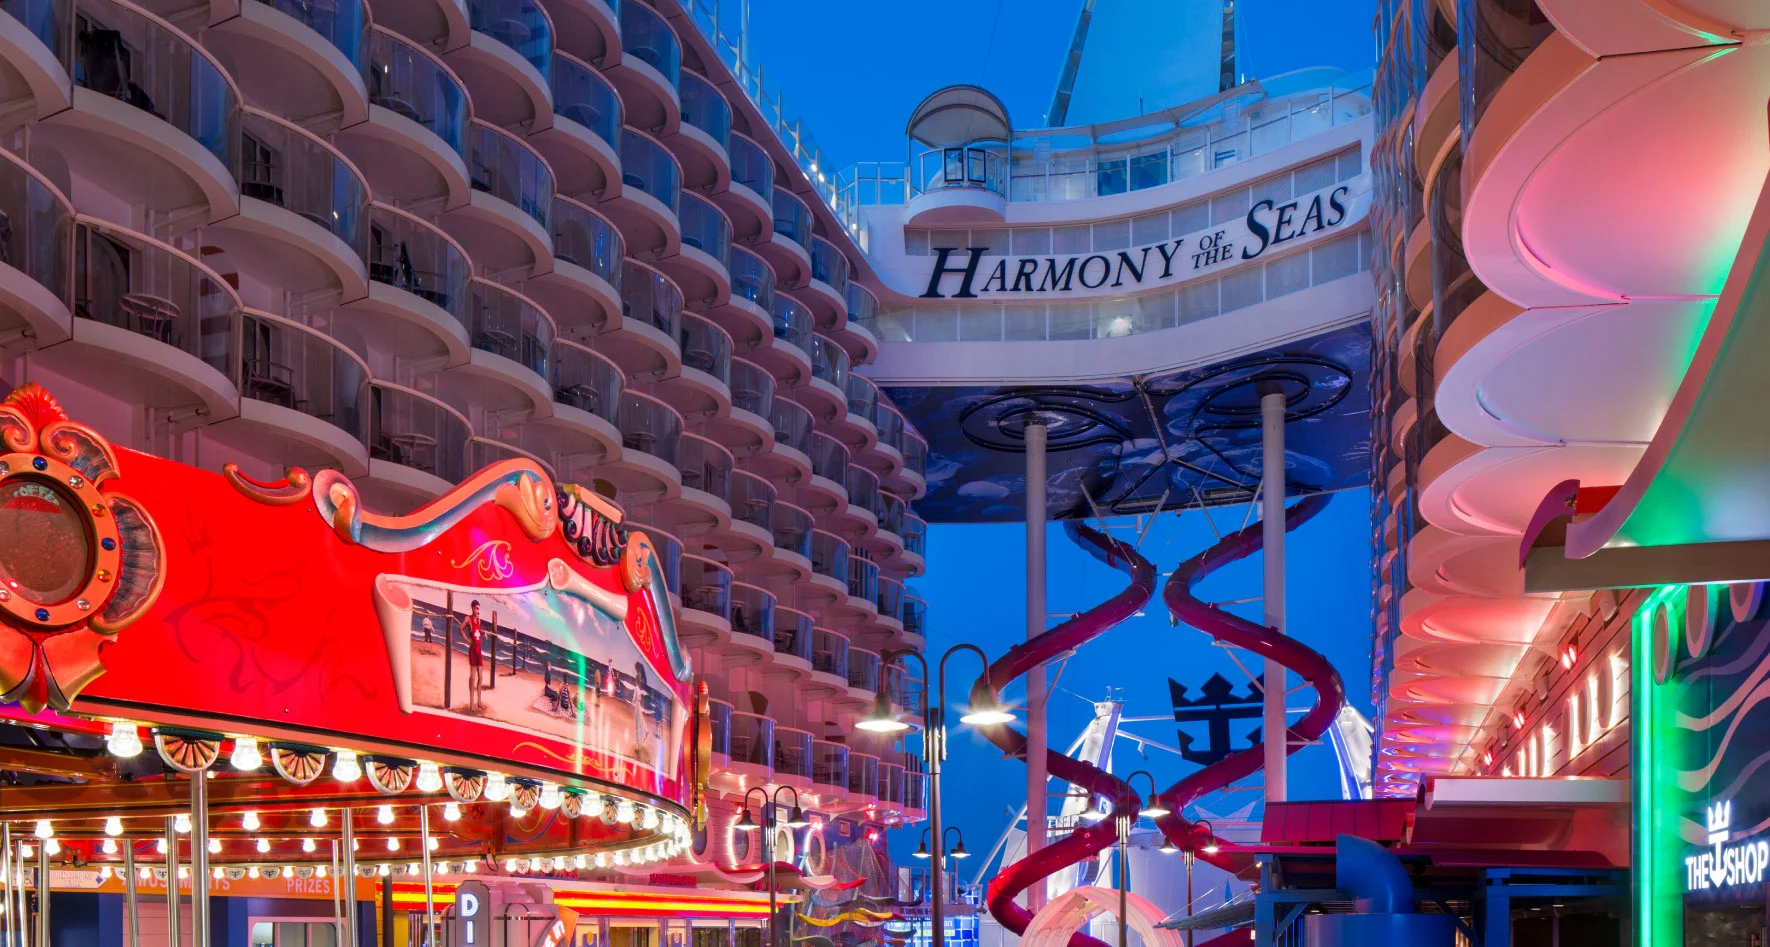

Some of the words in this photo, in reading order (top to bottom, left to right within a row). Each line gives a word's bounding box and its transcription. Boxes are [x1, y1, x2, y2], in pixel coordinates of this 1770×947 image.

[1198, 229, 1226, 251] OF
[1241, 185, 1349, 260] SEAS
[919, 239, 1184, 299] HARMONY
[1191, 243, 1233, 270] THE
[1685, 855, 1710, 891] THE
[1726, 840, 1769, 886] SHOP
[286, 879, 330, 894] PRIZES
